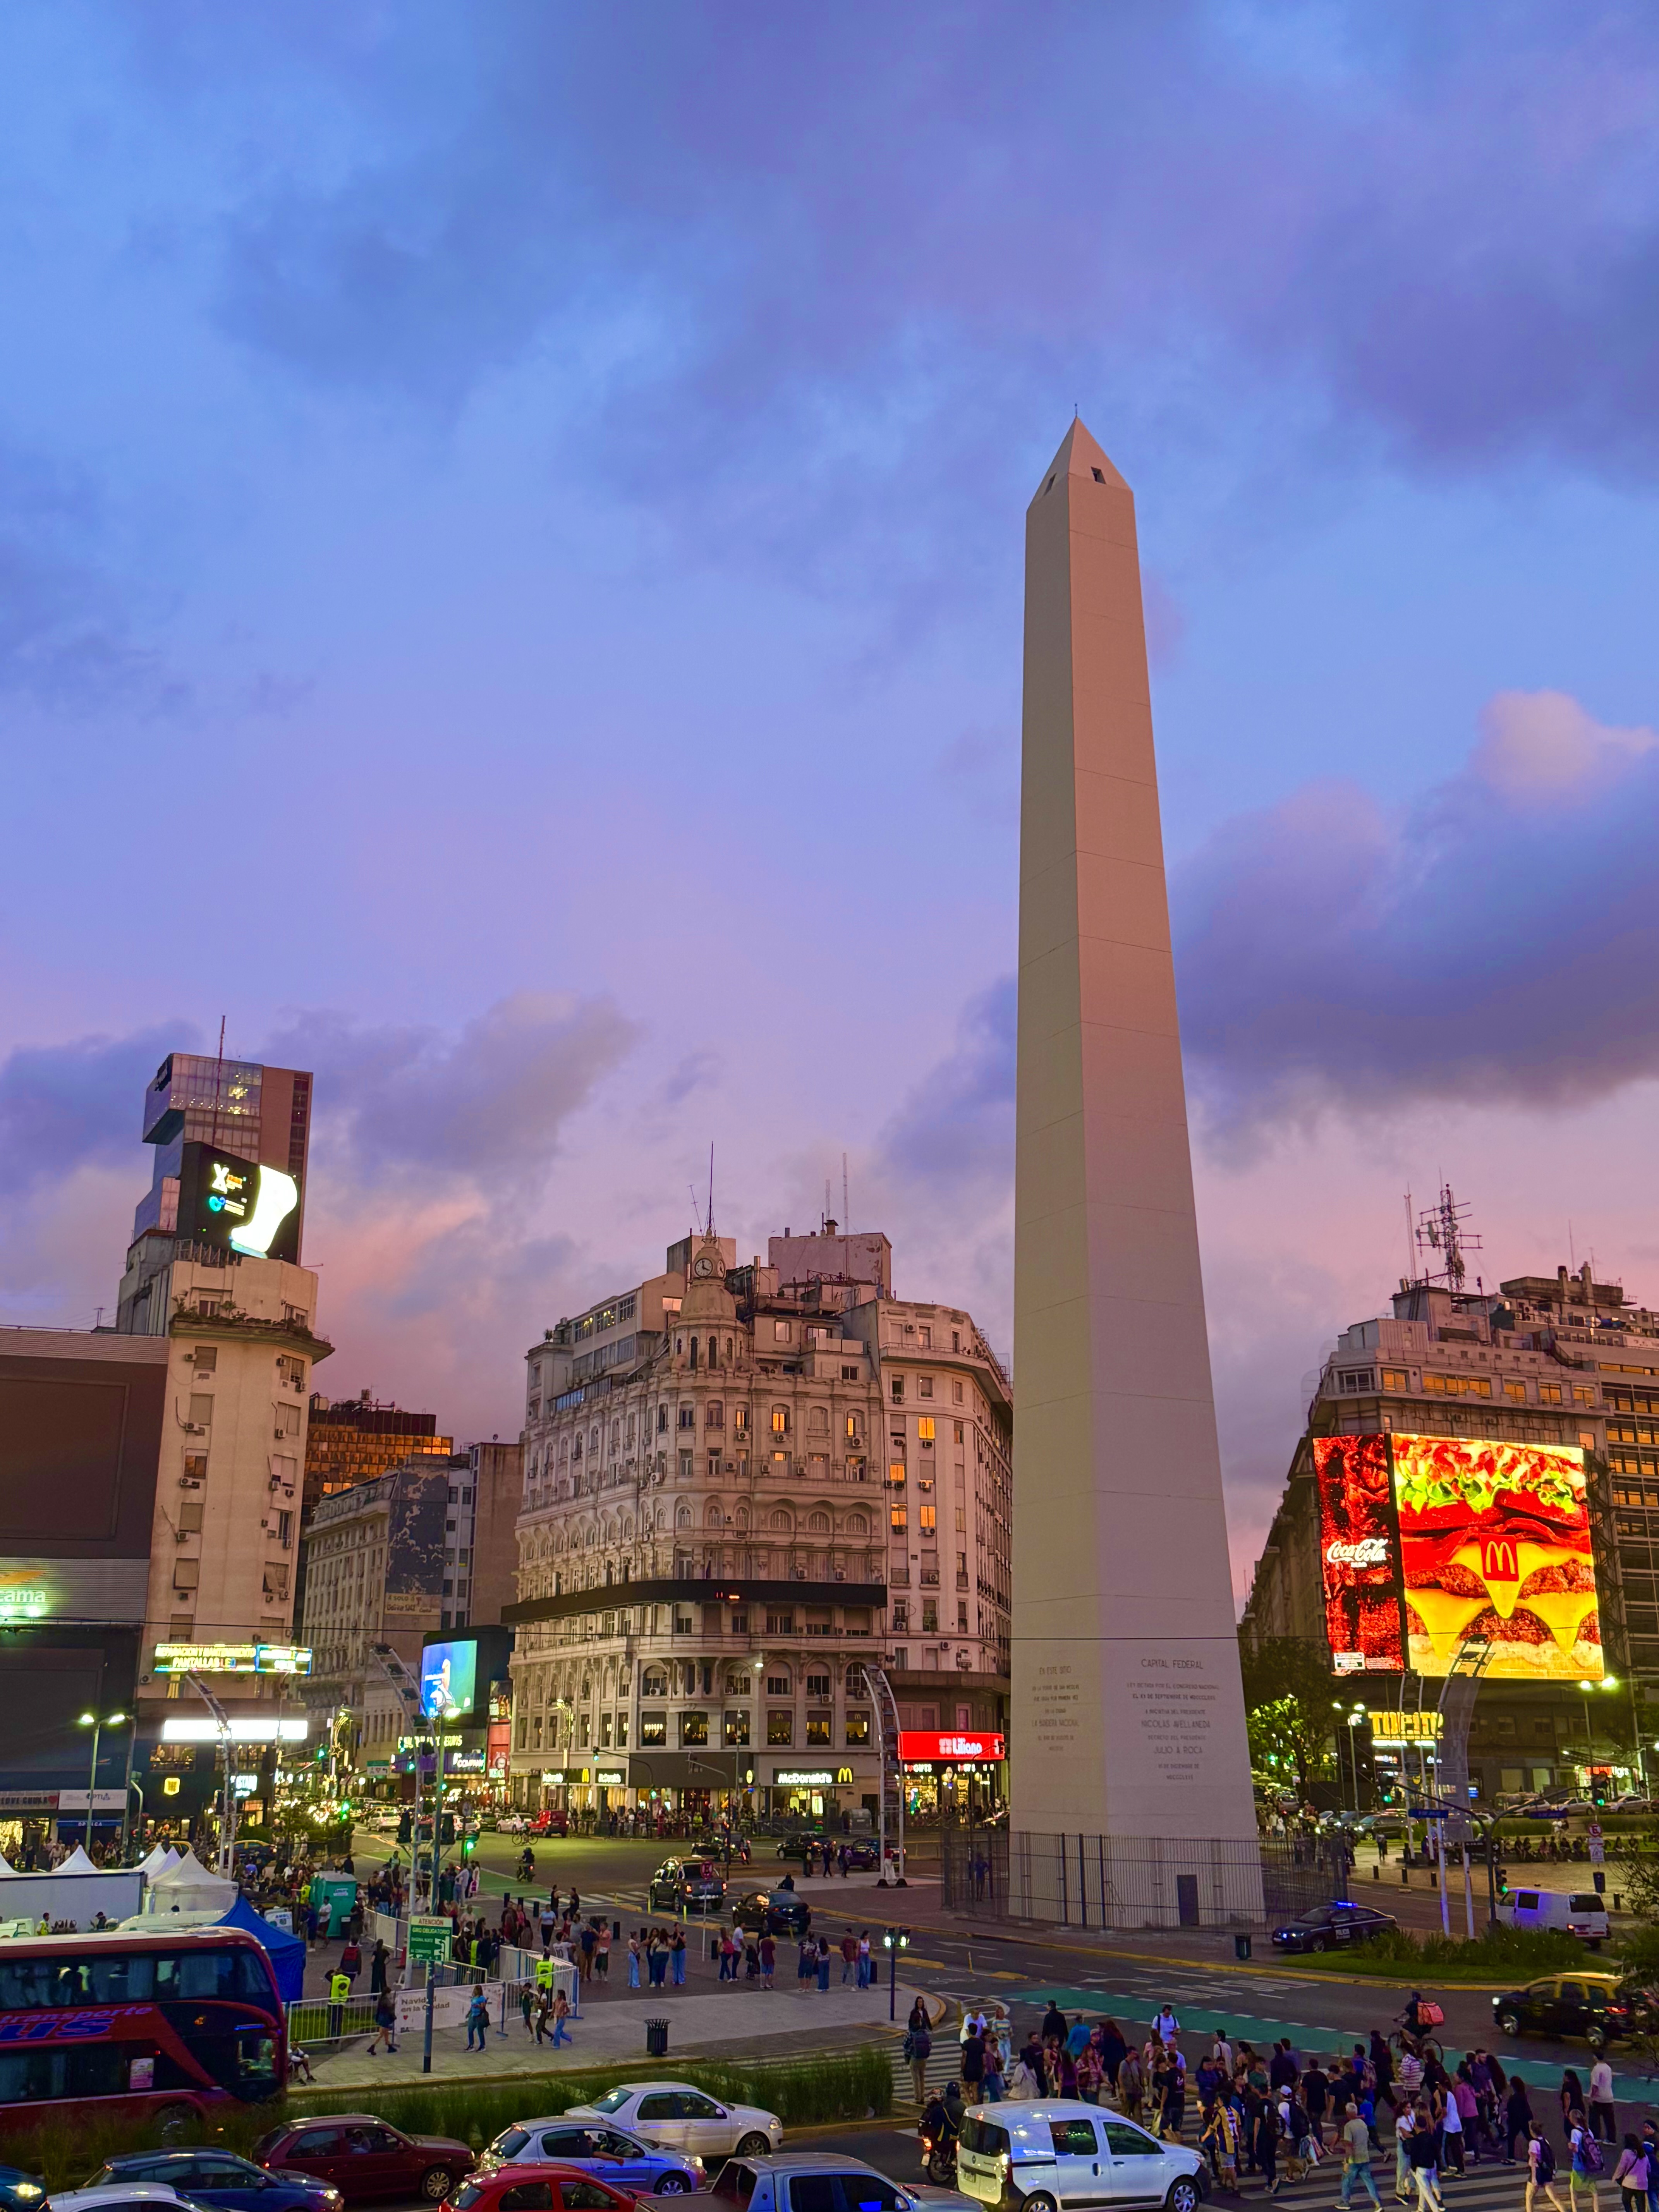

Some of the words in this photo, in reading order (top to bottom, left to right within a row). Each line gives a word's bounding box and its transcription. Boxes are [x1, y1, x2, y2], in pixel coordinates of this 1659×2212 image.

[1141, 1659, 1170, 1668] CAPITAL
[1173, 1660, 1204, 1669] FEDERAL
[1141, 1719, 1170, 1728] NICOLAS
[778, 1773, 832, 1784] McDonald's
[556, 1949, 563, 1958] 10
[402, 1996, 436, 2005] Navidd
[422, 2002, 450, 2011] Cdad
[1, 2007, 153, 2025] transporte
